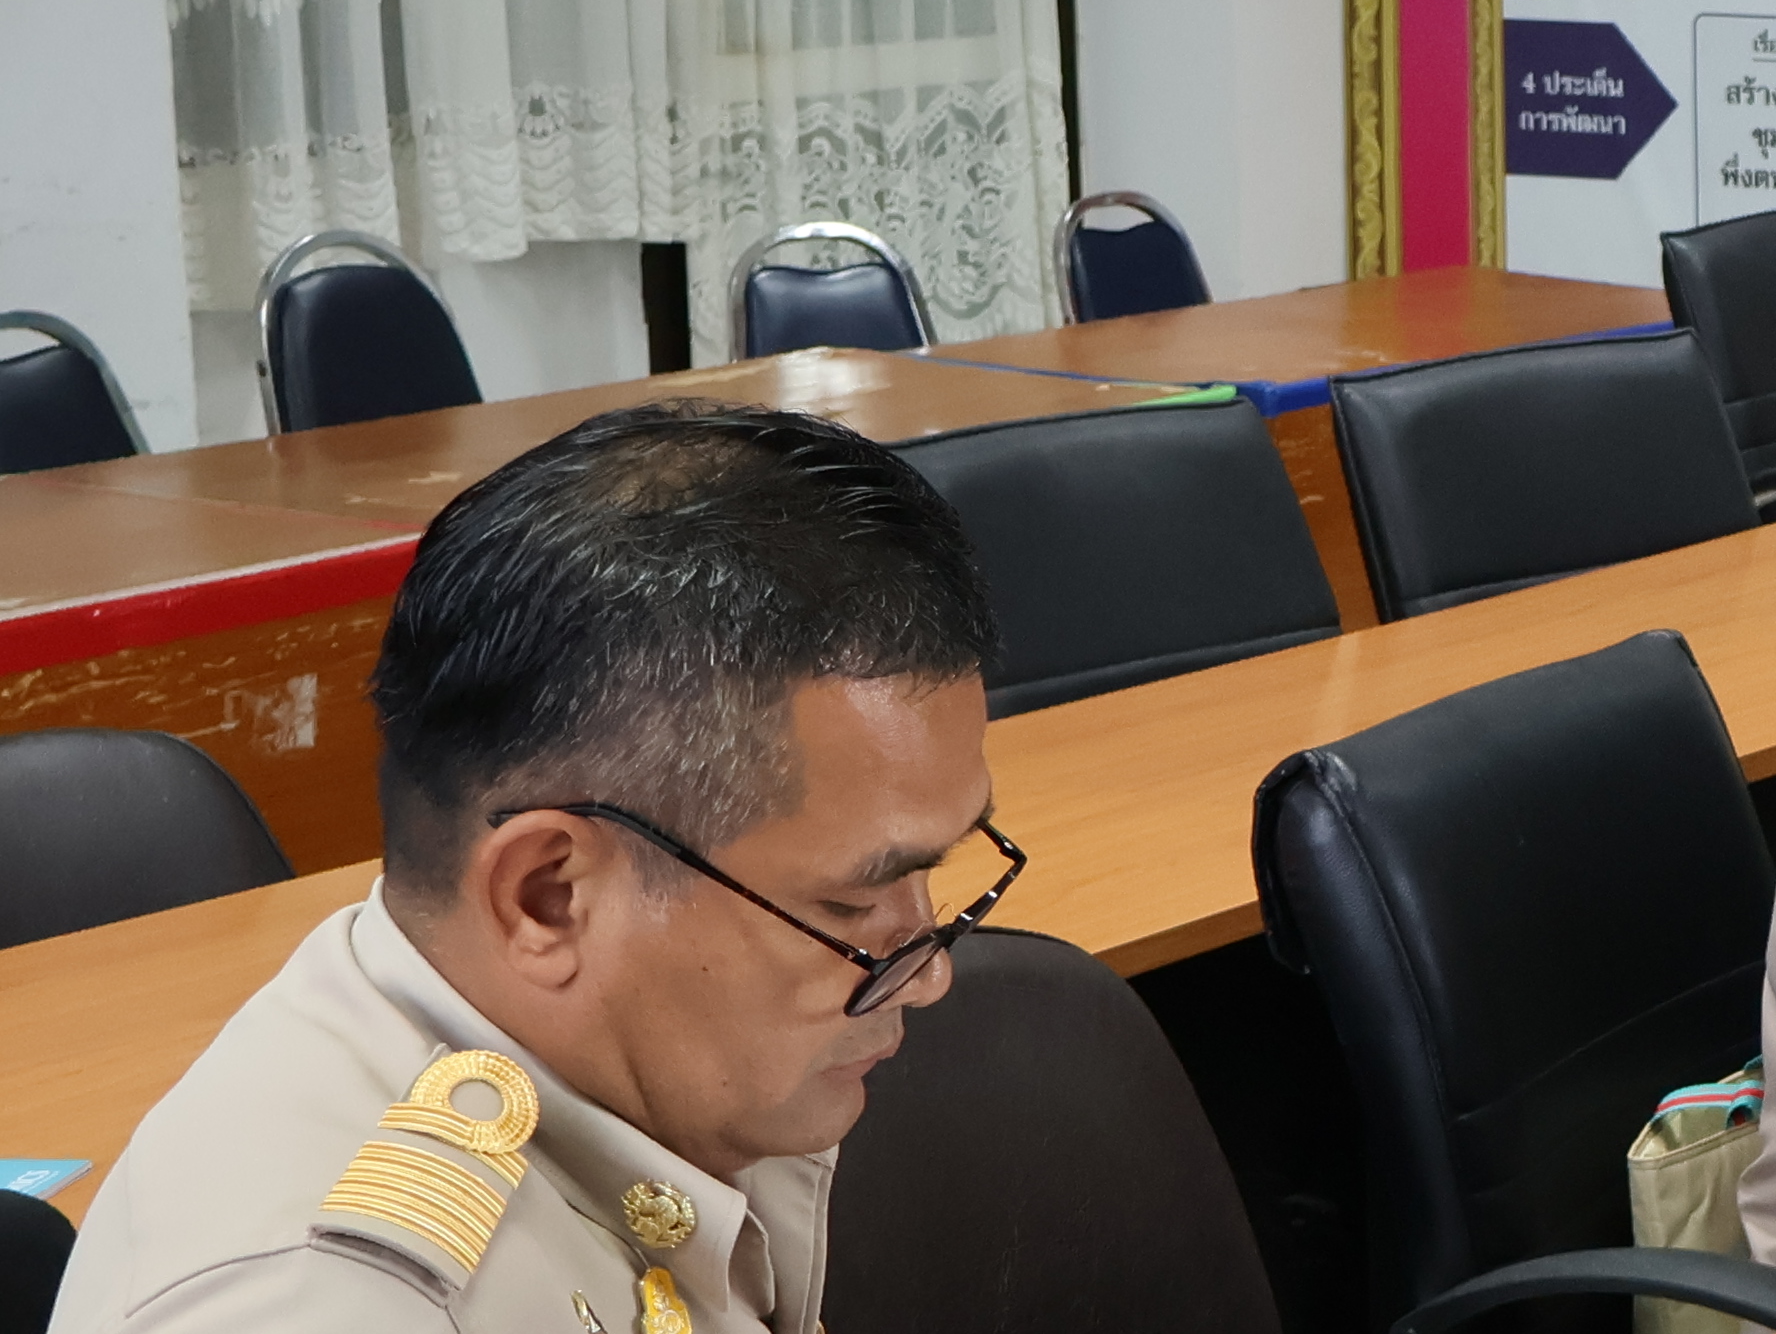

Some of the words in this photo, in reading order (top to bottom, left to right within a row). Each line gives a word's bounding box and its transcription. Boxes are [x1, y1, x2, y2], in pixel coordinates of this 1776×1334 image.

[1521, 72, 1536, 95] 4
[1543, 68, 1625, 98] ประเด็น
[1518, 106, 1627, 136] การพัฒนา
